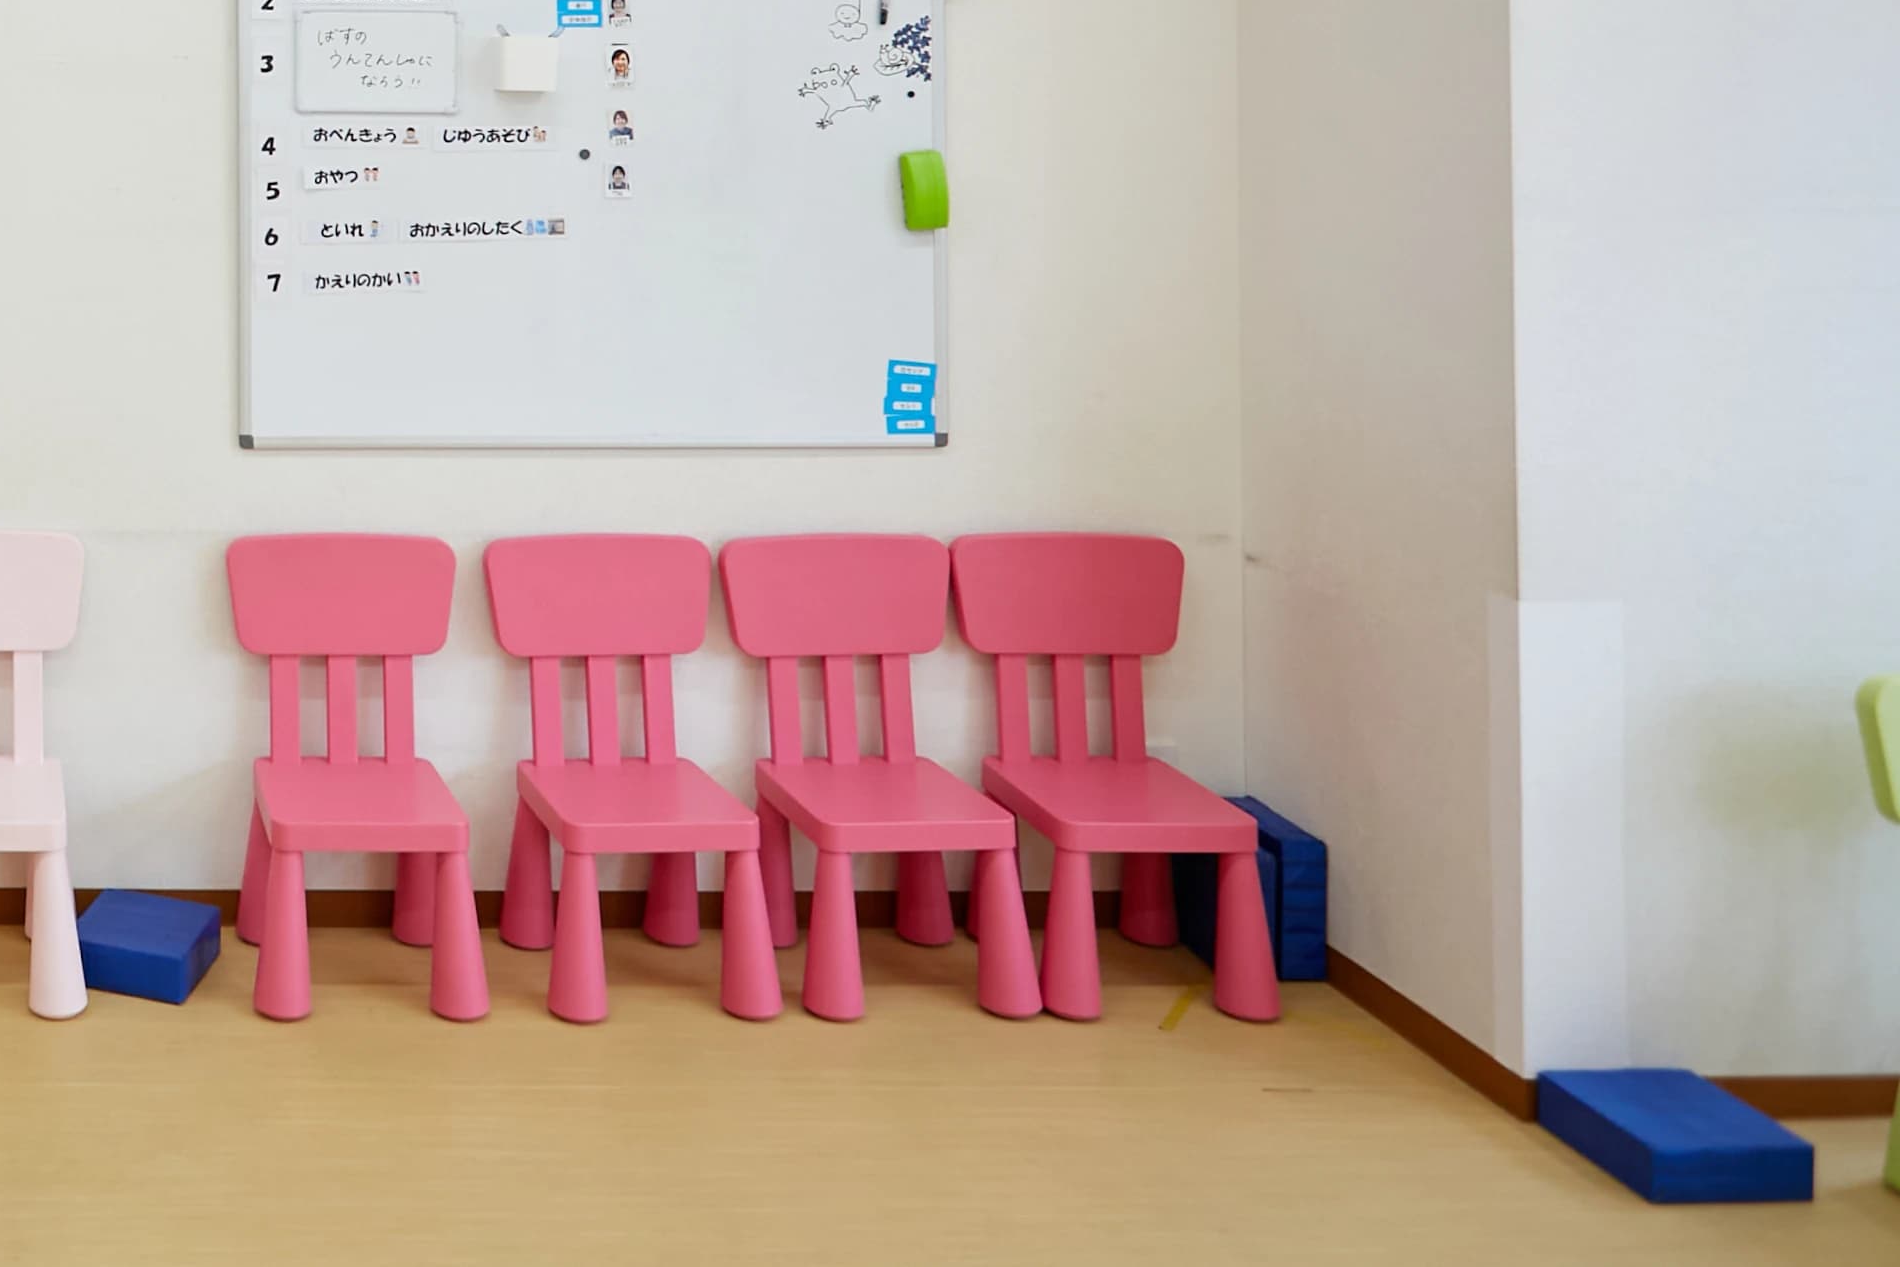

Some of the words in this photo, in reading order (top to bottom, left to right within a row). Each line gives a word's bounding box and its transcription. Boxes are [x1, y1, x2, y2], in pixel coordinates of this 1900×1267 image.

[317, 28, 368, 47] ばすの
[259, 54, 274, 74] 3
[329, 49, 434, 70] うんてんしゅに
[260, 136, 277, 156] 4
[312, 127, 397, 143] おべんきょう
[442, 127, 531, 144] じゆうあそび
[265, 181, 281, 201] 5
[313, 168, 359, 185] おやつ
[263, 227, 279, 247] 6
[320, 222, 365, 239] といれ
[409, 219, 523, 238] おかえりのしたく
[266, 273, 282, 293] 7
[314, 271, 402, 290] かえりのかい
